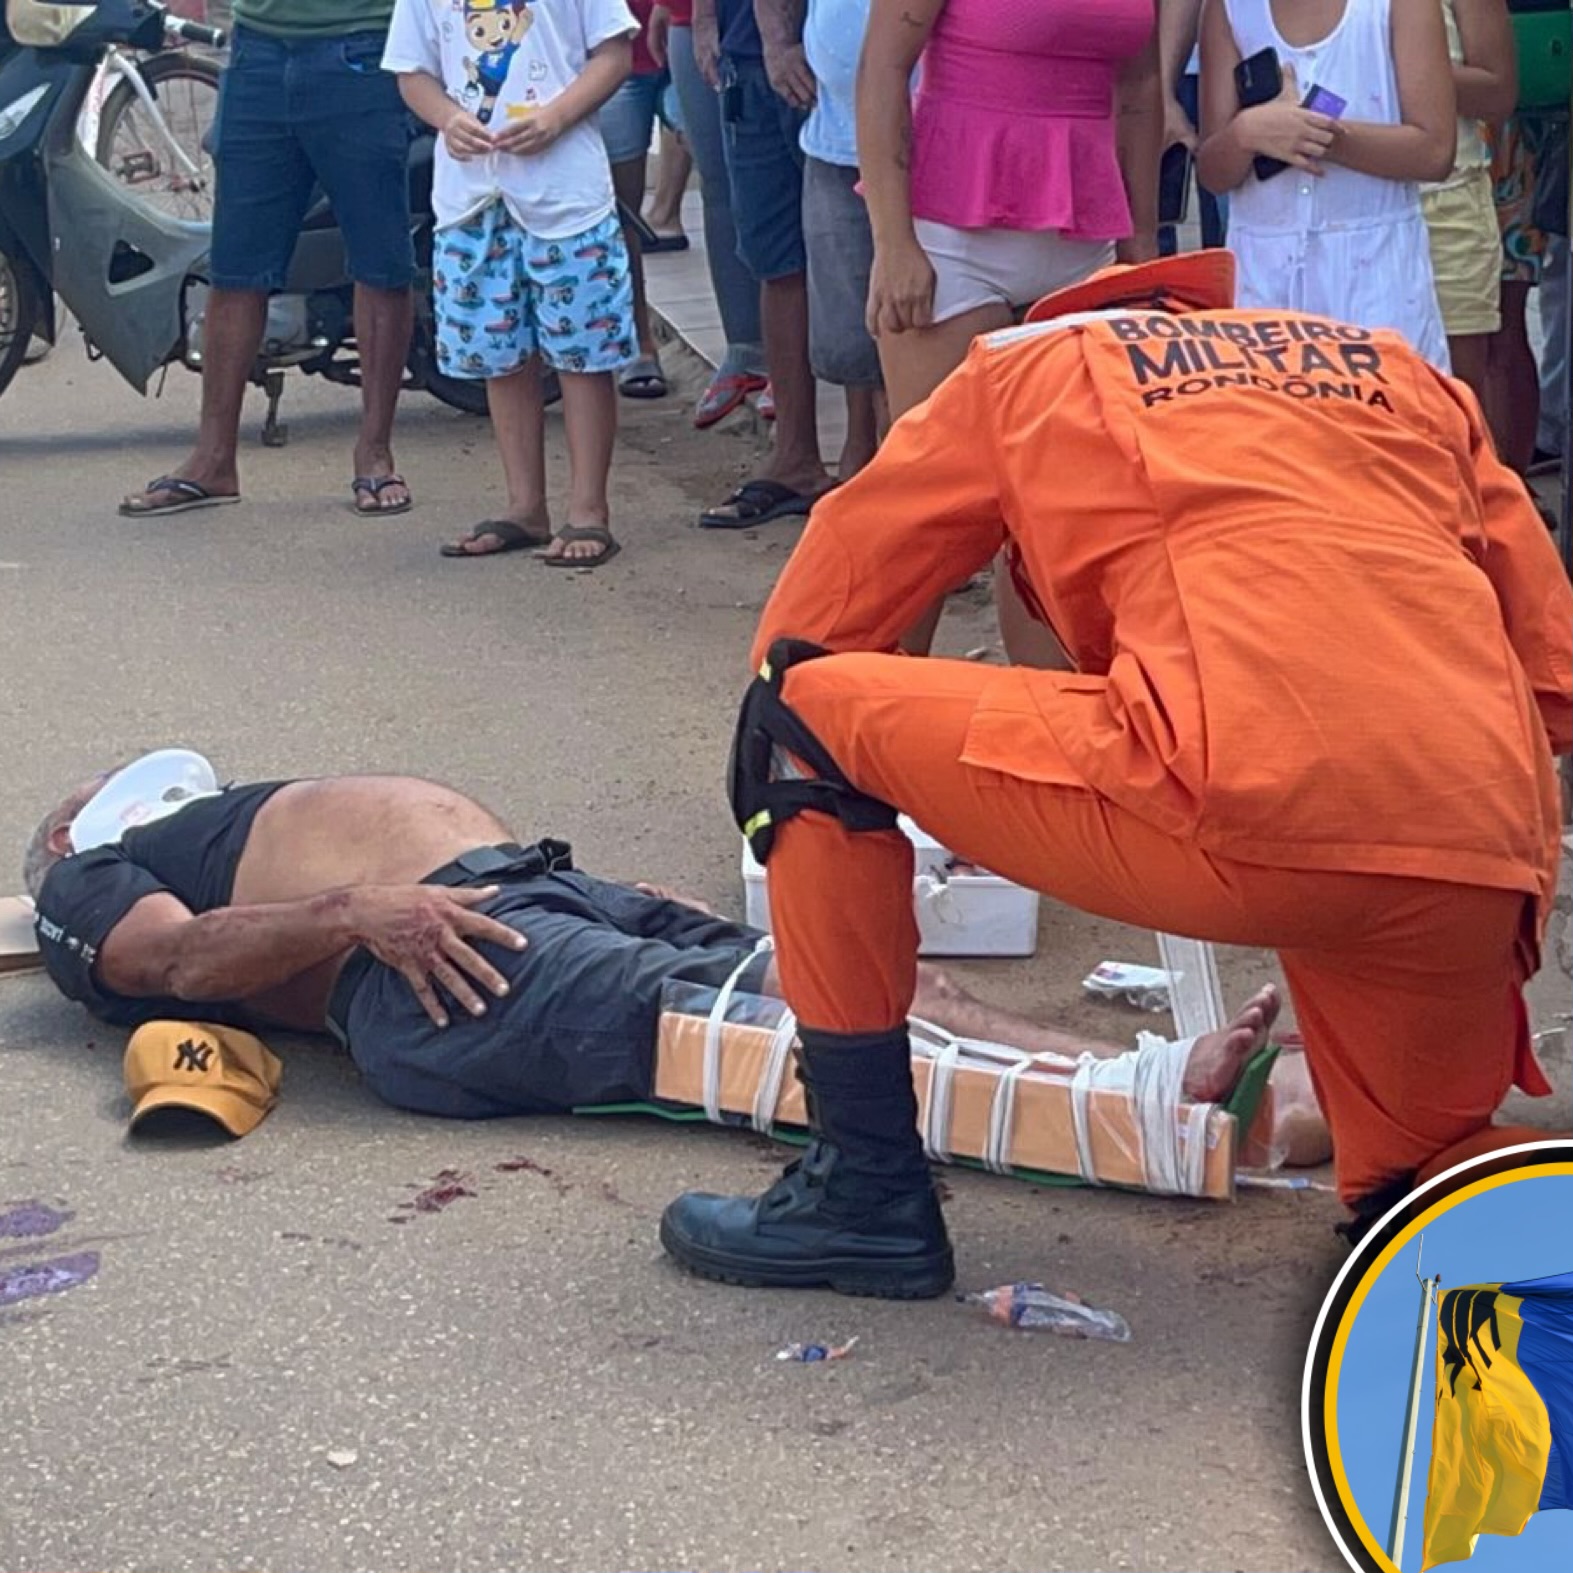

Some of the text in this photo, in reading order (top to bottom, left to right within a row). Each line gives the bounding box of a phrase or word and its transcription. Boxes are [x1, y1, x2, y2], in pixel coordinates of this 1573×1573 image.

[1105, 315, 1371, 349] BOMBEIRO
[1126, 340, 1391, 385] MILITAR
[1141, 372, 1395, 414] RONDÔNIA
